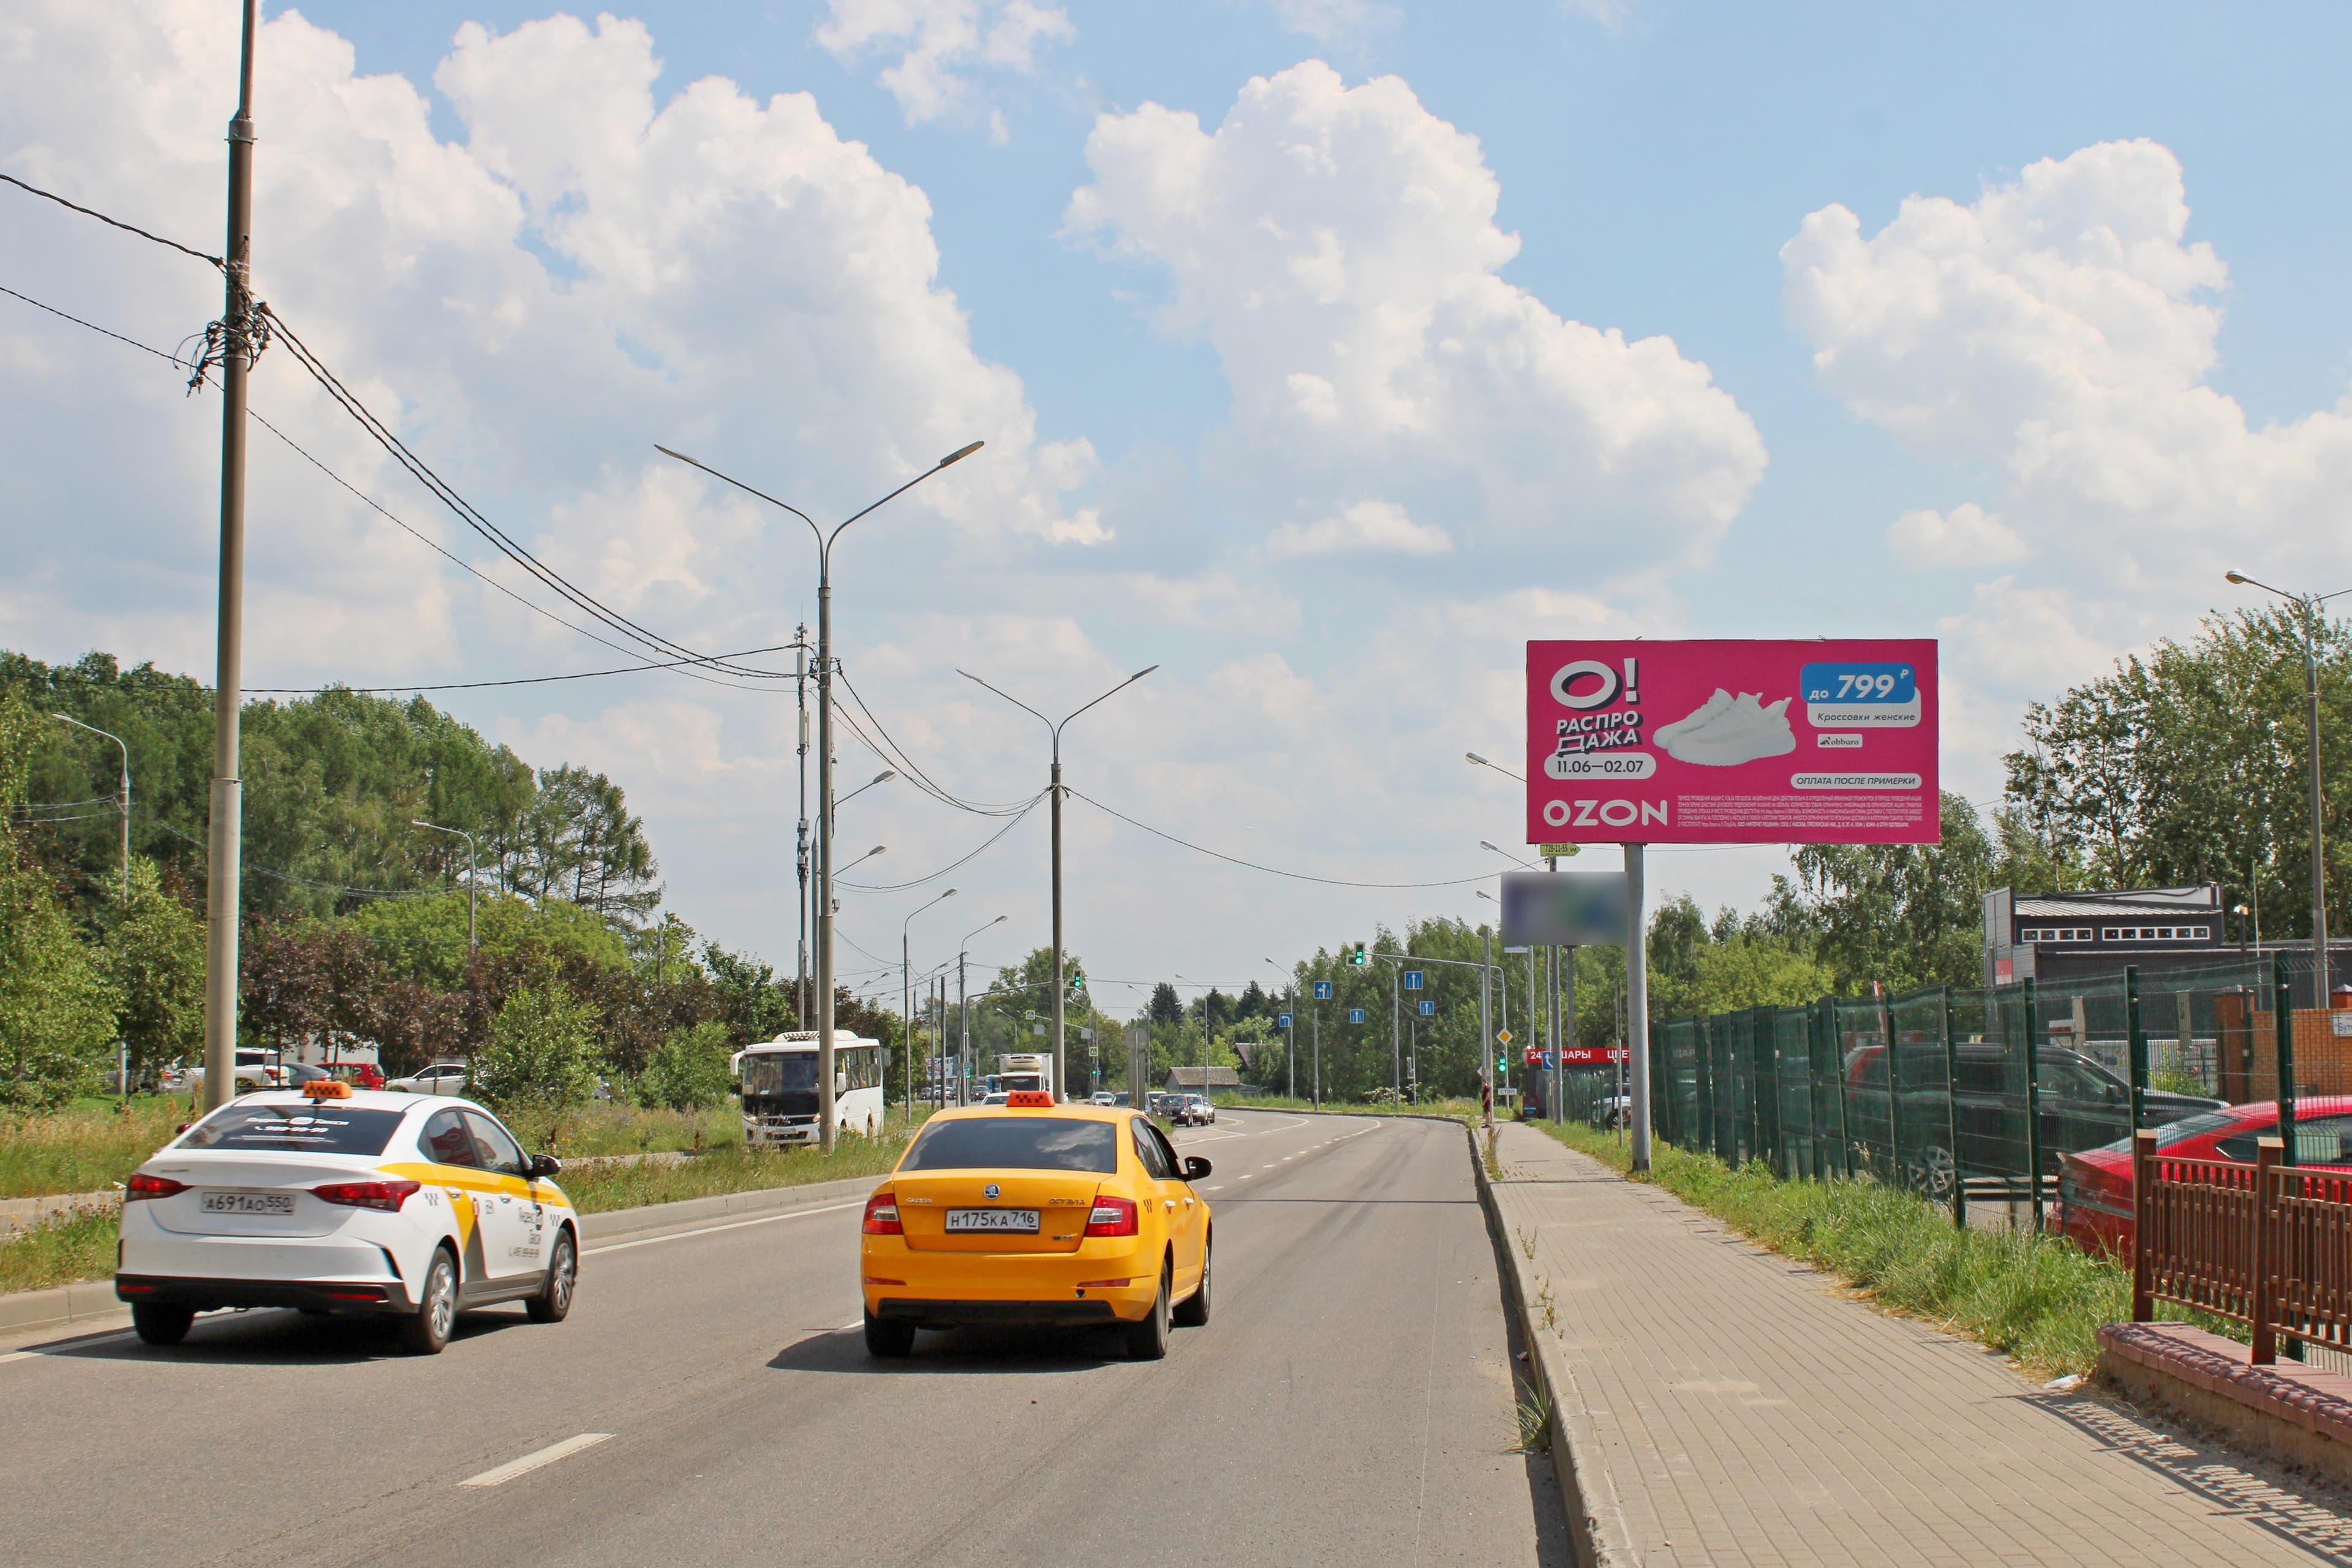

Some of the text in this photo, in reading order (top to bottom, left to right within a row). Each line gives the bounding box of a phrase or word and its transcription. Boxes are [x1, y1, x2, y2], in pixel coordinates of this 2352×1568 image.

[1809, 690, 1829, 700] до
[1836, 674, 1894, 698] 799
[1556, 710, 1641, 735] РАСПРО
[1817, 712, 1870, 722] Кроссовки
[1555, 729, 1640, 756] ДАЖА
[1543, 799, 1668, 827] OZON
